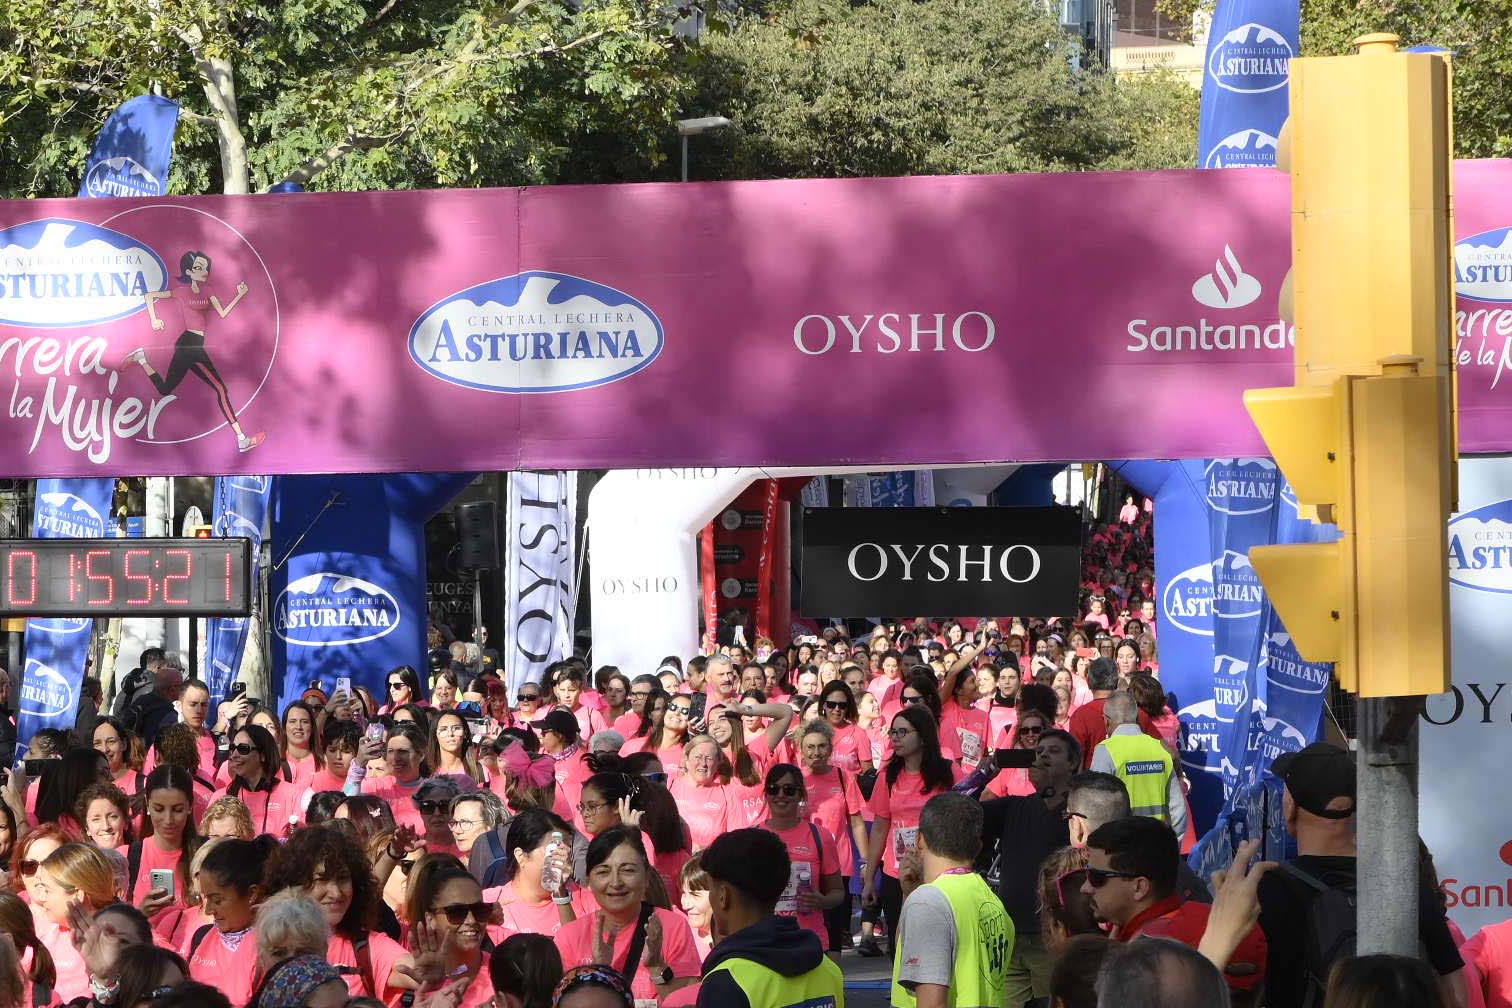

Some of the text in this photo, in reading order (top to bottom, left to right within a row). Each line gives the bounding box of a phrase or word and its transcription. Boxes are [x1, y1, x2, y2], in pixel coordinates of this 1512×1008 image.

[1216, 50, 1289, 76] ASTURIANA
[467, 312, 636, 327] CENTRAL LECHERA
[793, 311, 997, 355] OYSHO
[428, 318, 644, 363] ASTURIANA
[1127, 318, 1295, 352] Santand
[8, 381, 33, 419] la
[28, 369, 178, 464] Mujer
[1475, 530, 1512, 540] CENT
[847, 541, 1042, 583] OYSHO
[277, 606, 391, 630] ASTURIANA
[1189, 722, 1217, 730] CENT
